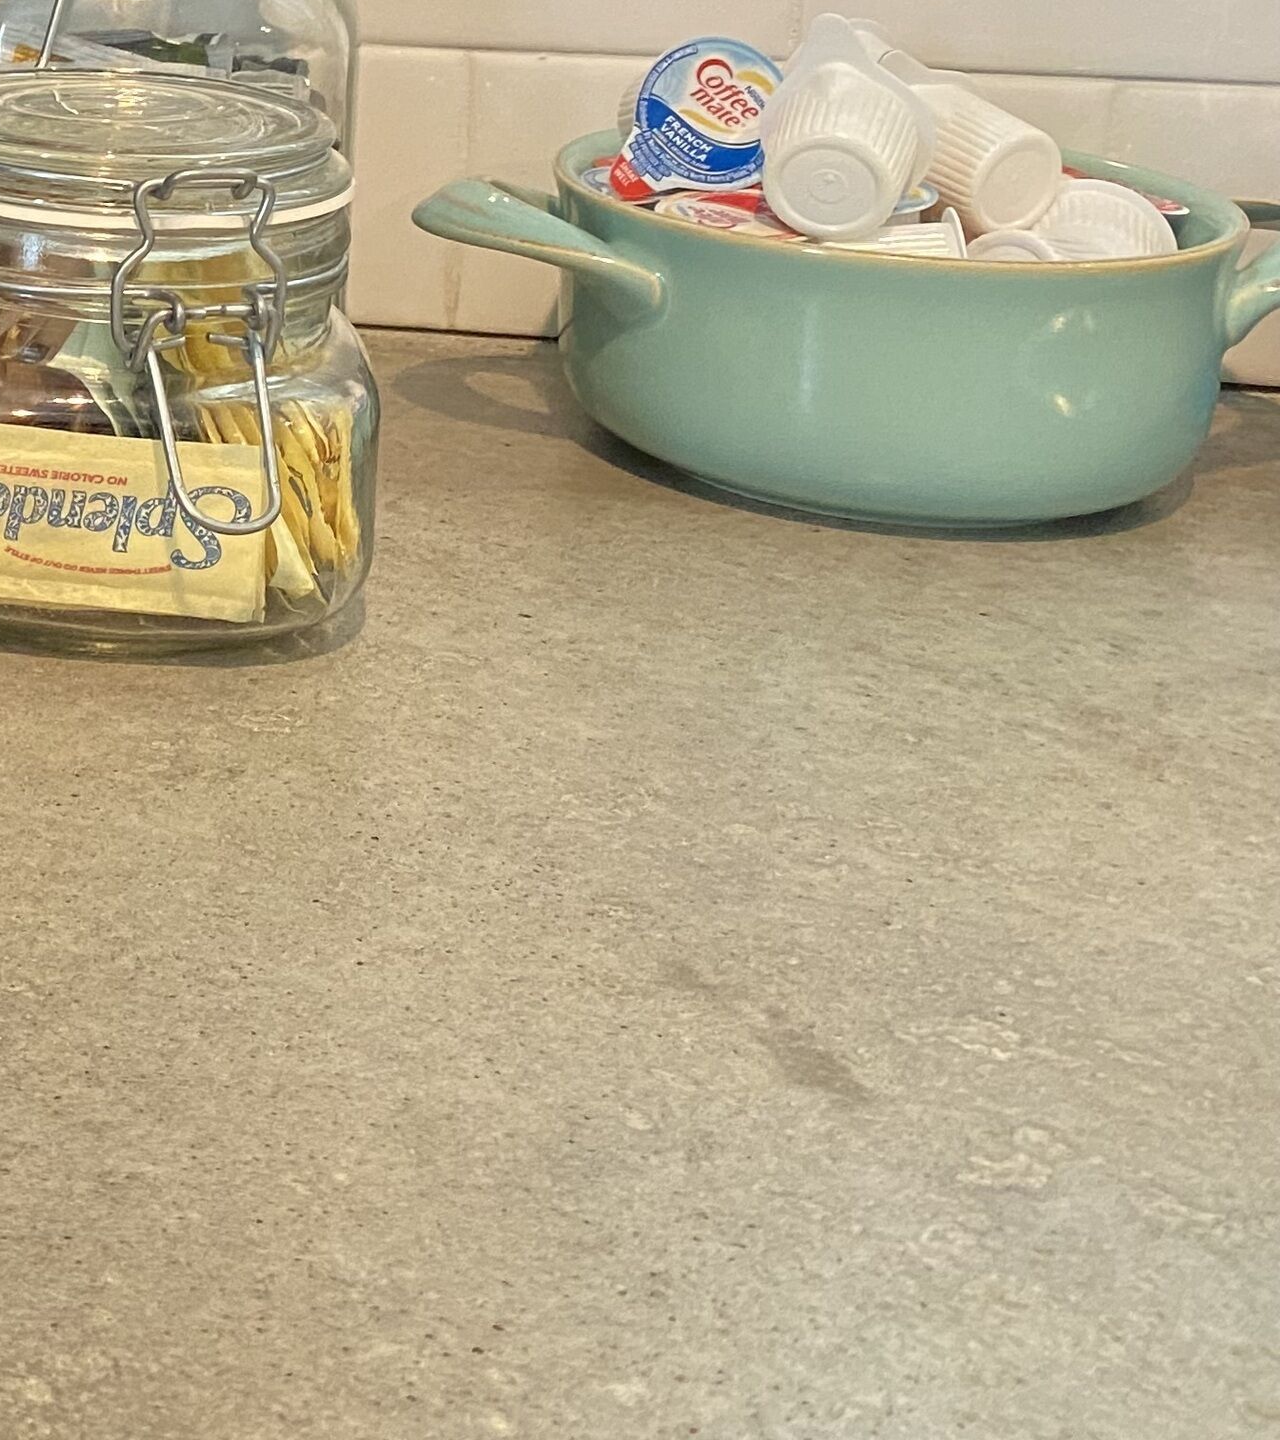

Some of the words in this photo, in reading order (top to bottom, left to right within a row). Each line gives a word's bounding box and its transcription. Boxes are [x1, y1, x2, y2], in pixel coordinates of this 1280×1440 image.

[690, 88, 740, 127] mate
[697, 59, 759, 119] Coffee
[660, 124, 708, 162] VANILLA
[665, 116, 713, 152] FRENCH
[49, 471, 104, 484] CALORIE
[107, 476, 127, 486] NO
